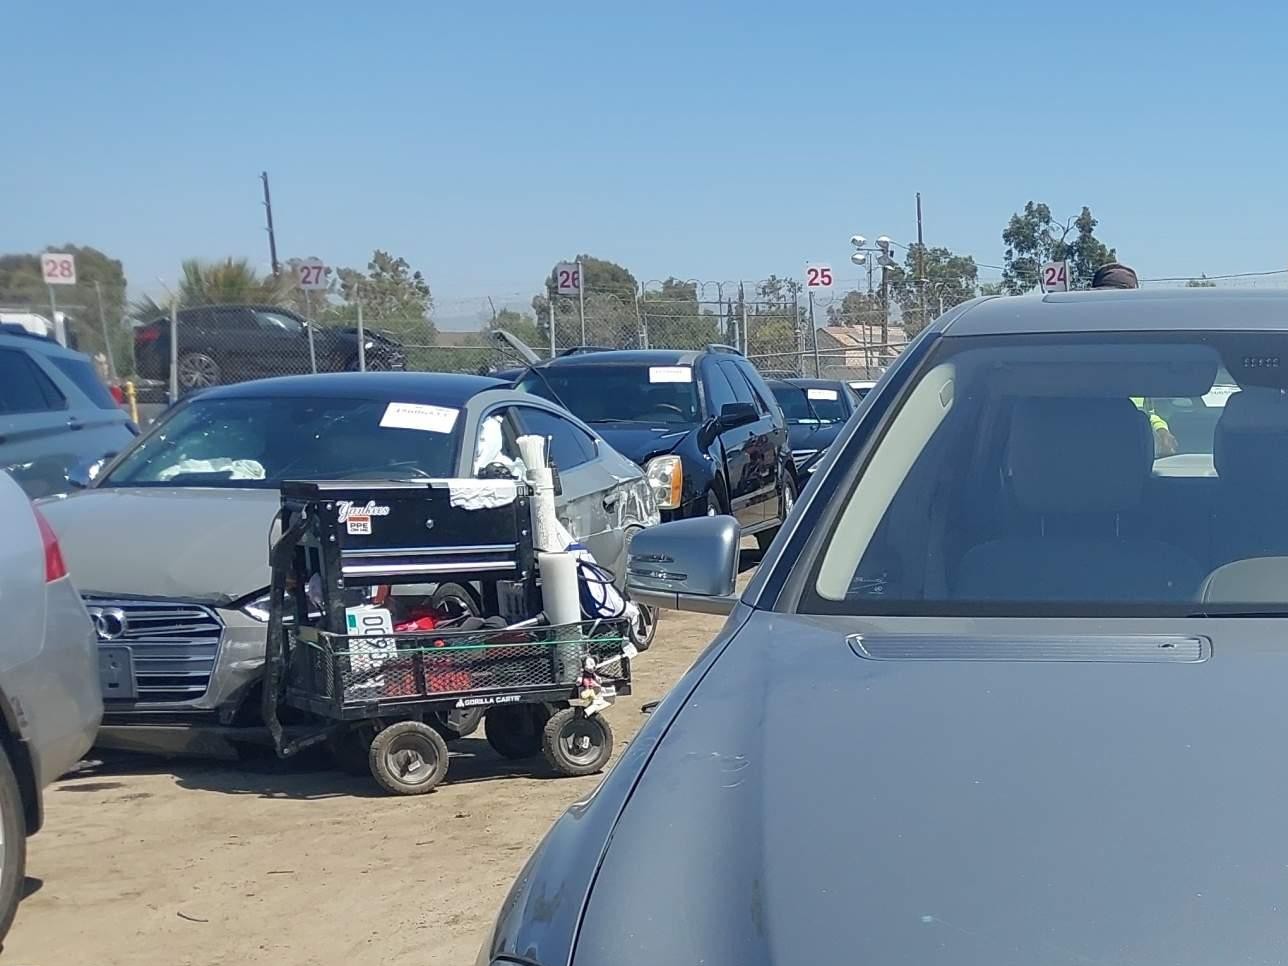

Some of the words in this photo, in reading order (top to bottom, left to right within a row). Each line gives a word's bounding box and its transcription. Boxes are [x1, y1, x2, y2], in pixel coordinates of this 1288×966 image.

[47, 259, 71, 278] 28
[300, 266, 322, 284] 27
[808, 268, 832, 286] 25
[1046, 267, 1065, 286] 24
[560, 270, 580, 288] 26
[335, 500, 390, 523] Yankees
[465, 698, 494, 706] GORILLA
